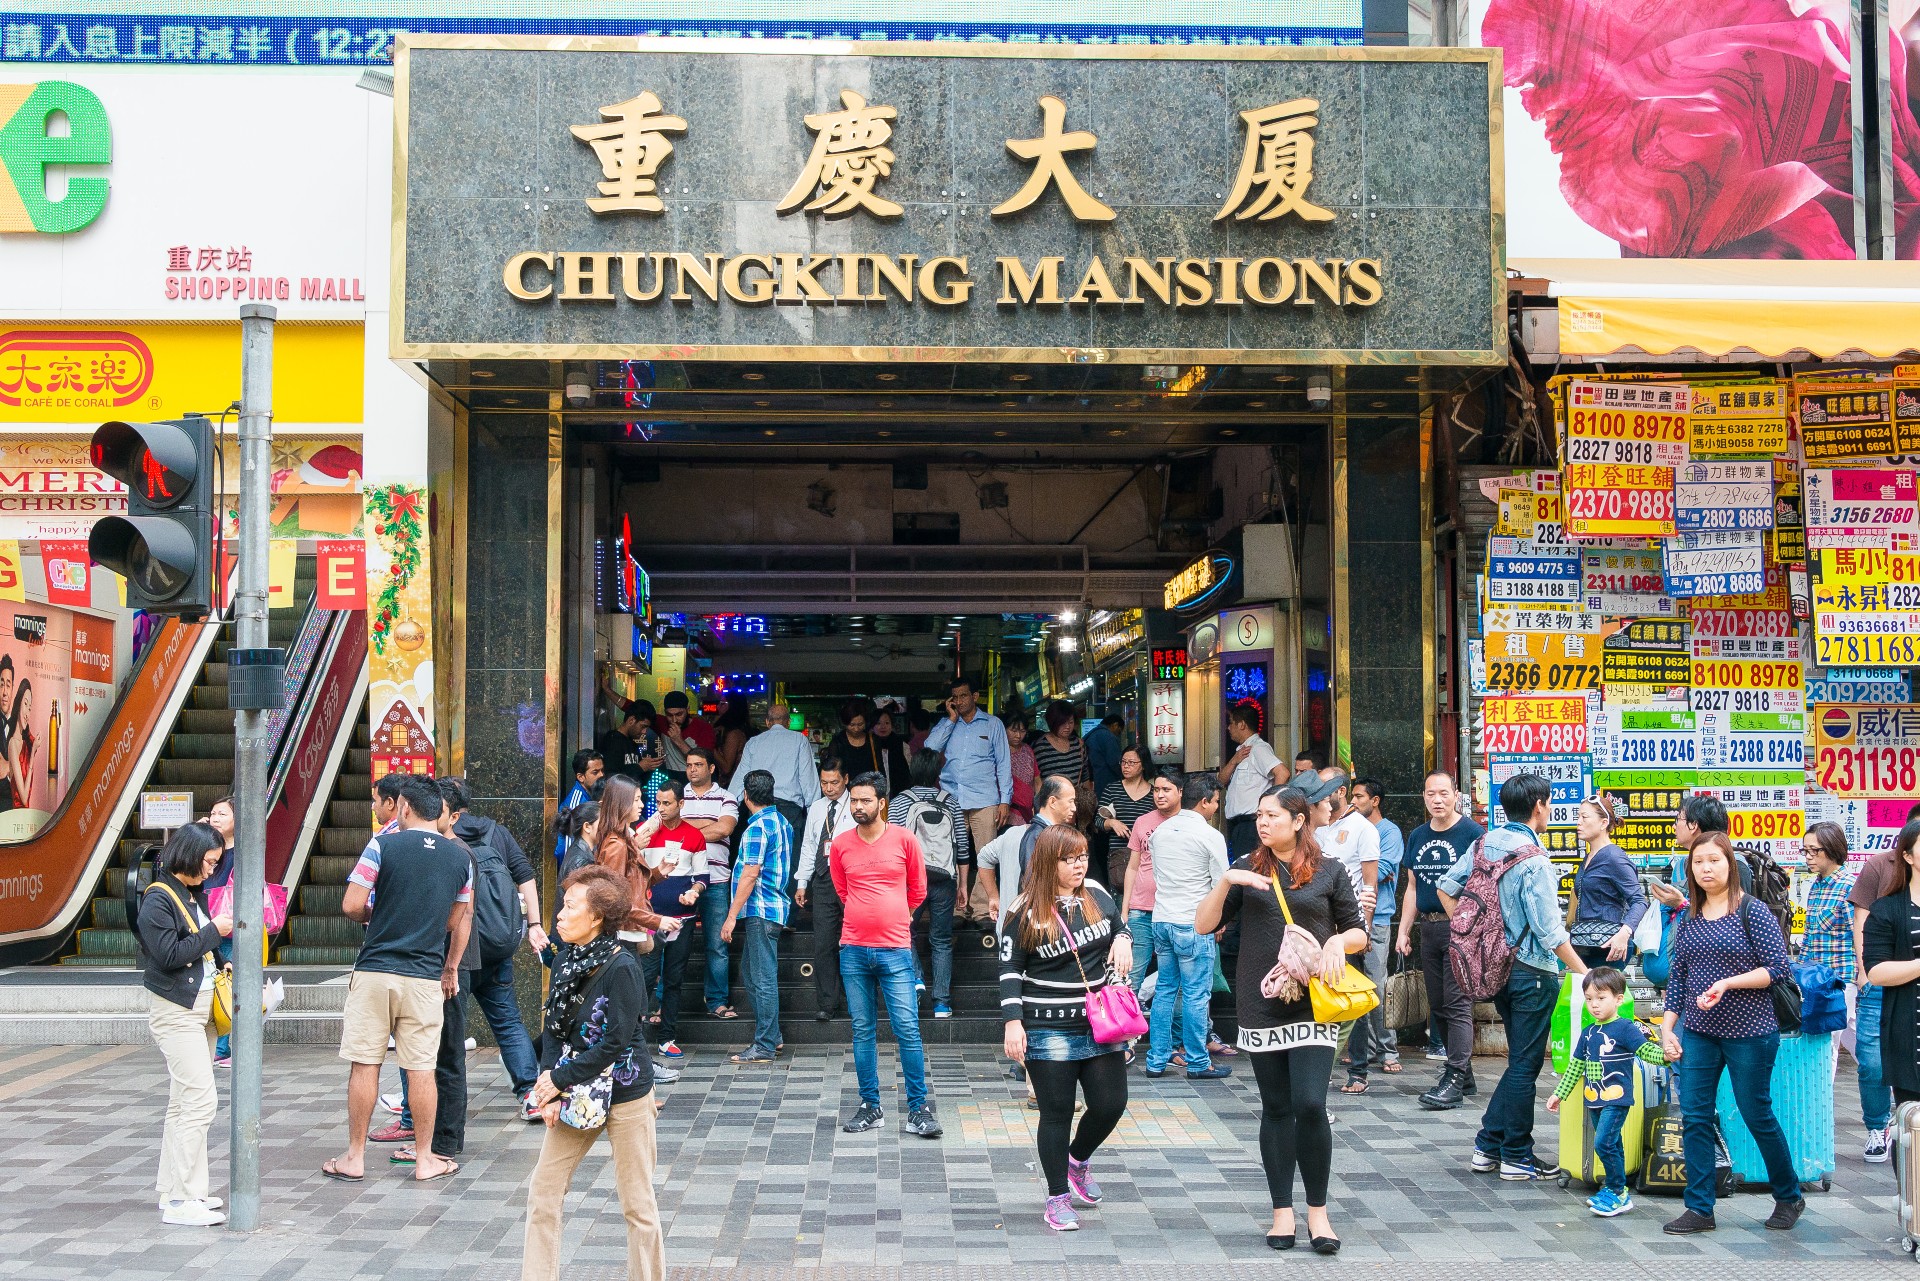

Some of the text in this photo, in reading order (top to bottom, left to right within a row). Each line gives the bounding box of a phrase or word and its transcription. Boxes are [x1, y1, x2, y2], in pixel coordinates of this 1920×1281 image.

[166, 245, 253, 272] 重庆站
[164, 277, 365, 301] SHOPPING MALL
[502, 251, 1384, 309] CHUNGKING MANSIONS
[24, 396, 112, 408] CAFÉ DE CORAL
[1605, 388, 1673, 403] 田豐地產
[1719, 391, 1775, 408] 旺舖專家
[1826, 395, 1879, 414] 旺舖專家
[1573, 410, 1686, 441] 8100 8978
[1757, 423, 1783, 433] 7278
[1864, 427, 1891, 438] 0624
[1572, 439, 1653, 464] 2827 9818
[1693, 437, 1784, 449] 馮小姐9058 7697
[1866, 441, 1892, 453] 6691
[58, 456, 91, 465] wish
[1573, 463, 1675, 488] 利登旺舖
[1710, 465, 1766, 479] 力群物業
[1571, 489, 1621, 519] 2370
[1628, 490, 1674, 519] 9889
[1808, 489, 1821, 526] 宏星物業
[1701, 509, 1773, 528] 2802 8686
[1830, 506, 1872, 524] 3156
[1871, 507, 1914, 524] 2680
[39, 525, 80, 534] happy
[1574, 520, 1587, 533] 租
[1661, 521, 1673, 534] 售
[1701, 530, 1756, 545] 力群物業
[328, 557, 357, 596] E
[1495, 561, 1576, 575] 黃 9609 4775 生
[1492, 581, 1578, 598] 租 3188 4188 售
[1586, 573, 1665, 591] 2311 062
[1693, 573, 1763, 595] 2802 8686
[1587, 596, 1602, 610] 租
[1657, 597, 1672, 612] 售
[14, 616, 47, 637] mannings
[1516, 612, 1594, 629] 置榮物業
[1691, 610, 1790, 637] 2370 9889
[1838, 620, 1906, 633] 93636681
[1630, 624, 1682, 641] 旺舖專家
[1503, 632, 1586, 658] 租 售
[1721, 639, 1785, 652] 田豐地產
[1787, 639, 1799, 659] 旺舖
[75, 648, 110, 672] mannings
[1664, 657, 1690, 667] 0624
[1489, 662, 1600, 688] 2366 0772
[1664, 670, 1689, 681] 6691
[1694, 662, 1799, 688] 8100 8978
[1694, 690, 1770, 712] 2827 9818
[1806, 681, 1910, 703] 2309 2883
[1152, 683, 1179, 757] 許氏匯款
[1486, 700, 1582, 723] 利登旺舖
[1485, 724, 1585, 753] 2370 9889
[1592, 725, 1608, 767] 恒昌物業
[1699, 726, 1717, 767] 恒昌物業
[1621, 738, 1695, 762] 2388 8246
[1730, 739, 1803, 763] 2388 8246
[93, 720, 135, 810] mannings
[1820, 746, 1920, 792] 231138
[1569, 787, 1579, 799] 生
[1629, 792, 1681, 809] 旺舖專家
[1722, 789, 1786, 802] 田豐地產
[1788, 789, 1800, 807] 旺舖
[1751, 812, 1801, 837] 8978
[1416, 839, 1457, 863] ABERCROMBIE
[1418, 871, 1432, 885] NEW
[1035, 918, 1112, 959] WILLIMSBU
[1240, 1029, 1263, 1048] NS
